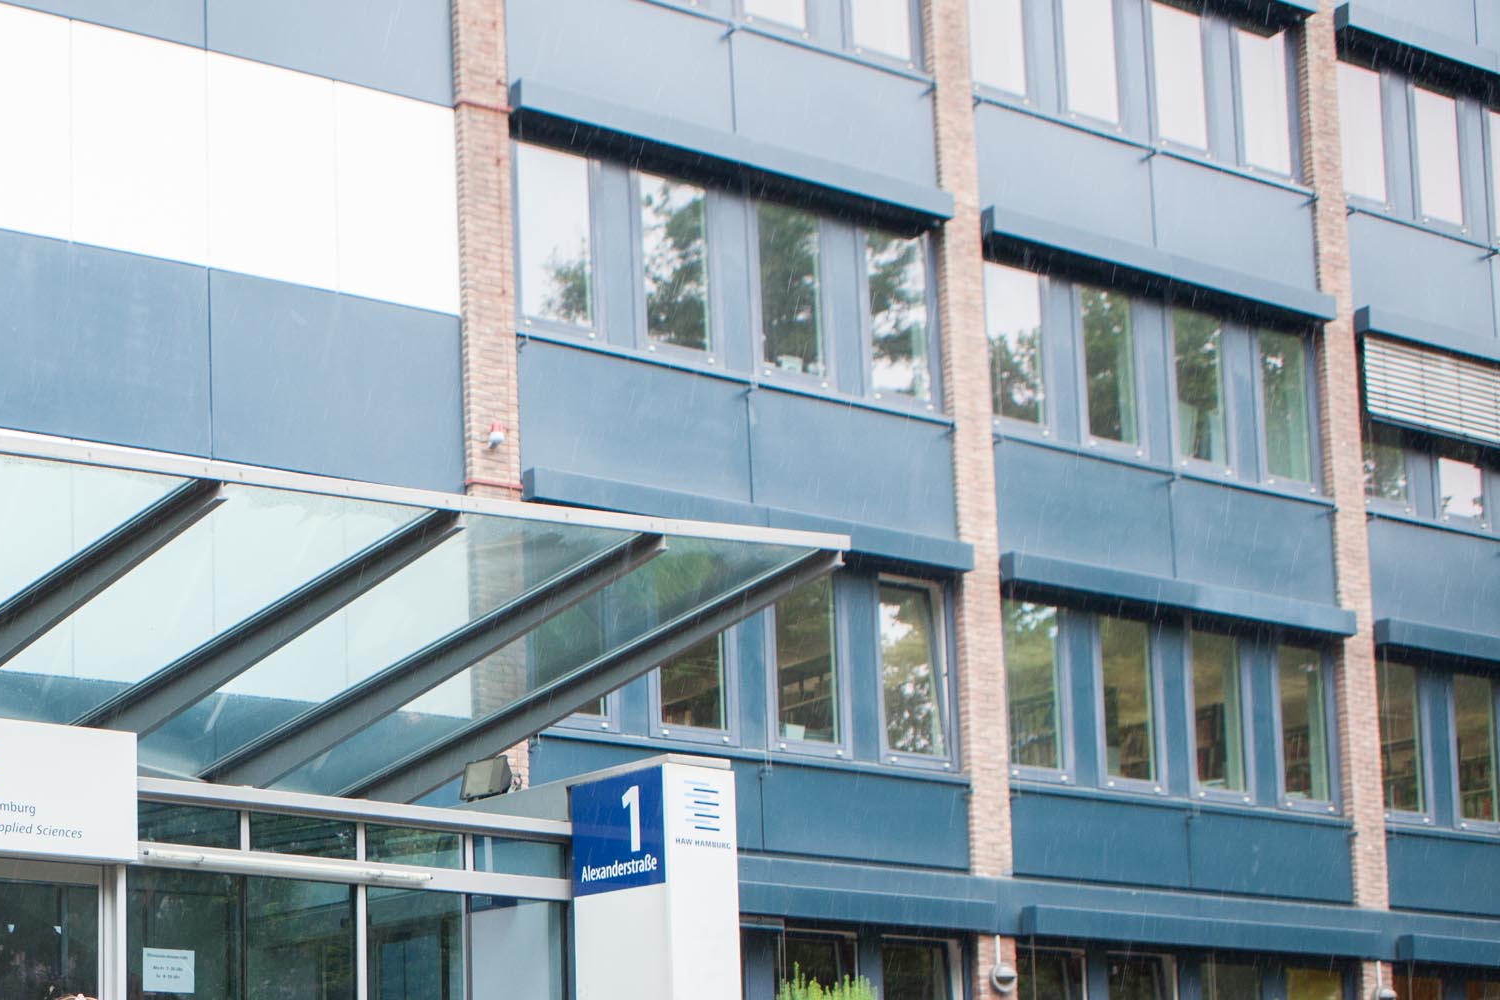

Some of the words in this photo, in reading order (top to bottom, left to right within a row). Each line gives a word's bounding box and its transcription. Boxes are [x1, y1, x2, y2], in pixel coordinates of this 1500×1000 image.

[621, 785, 642, 852] 1
[36, 824, 84, 839] Sciences
[675, 837, 693, 846] HAW
[695, 840, 731, 850] HAMBURG
[581, 853, 657, 883] Alexanderstraße
